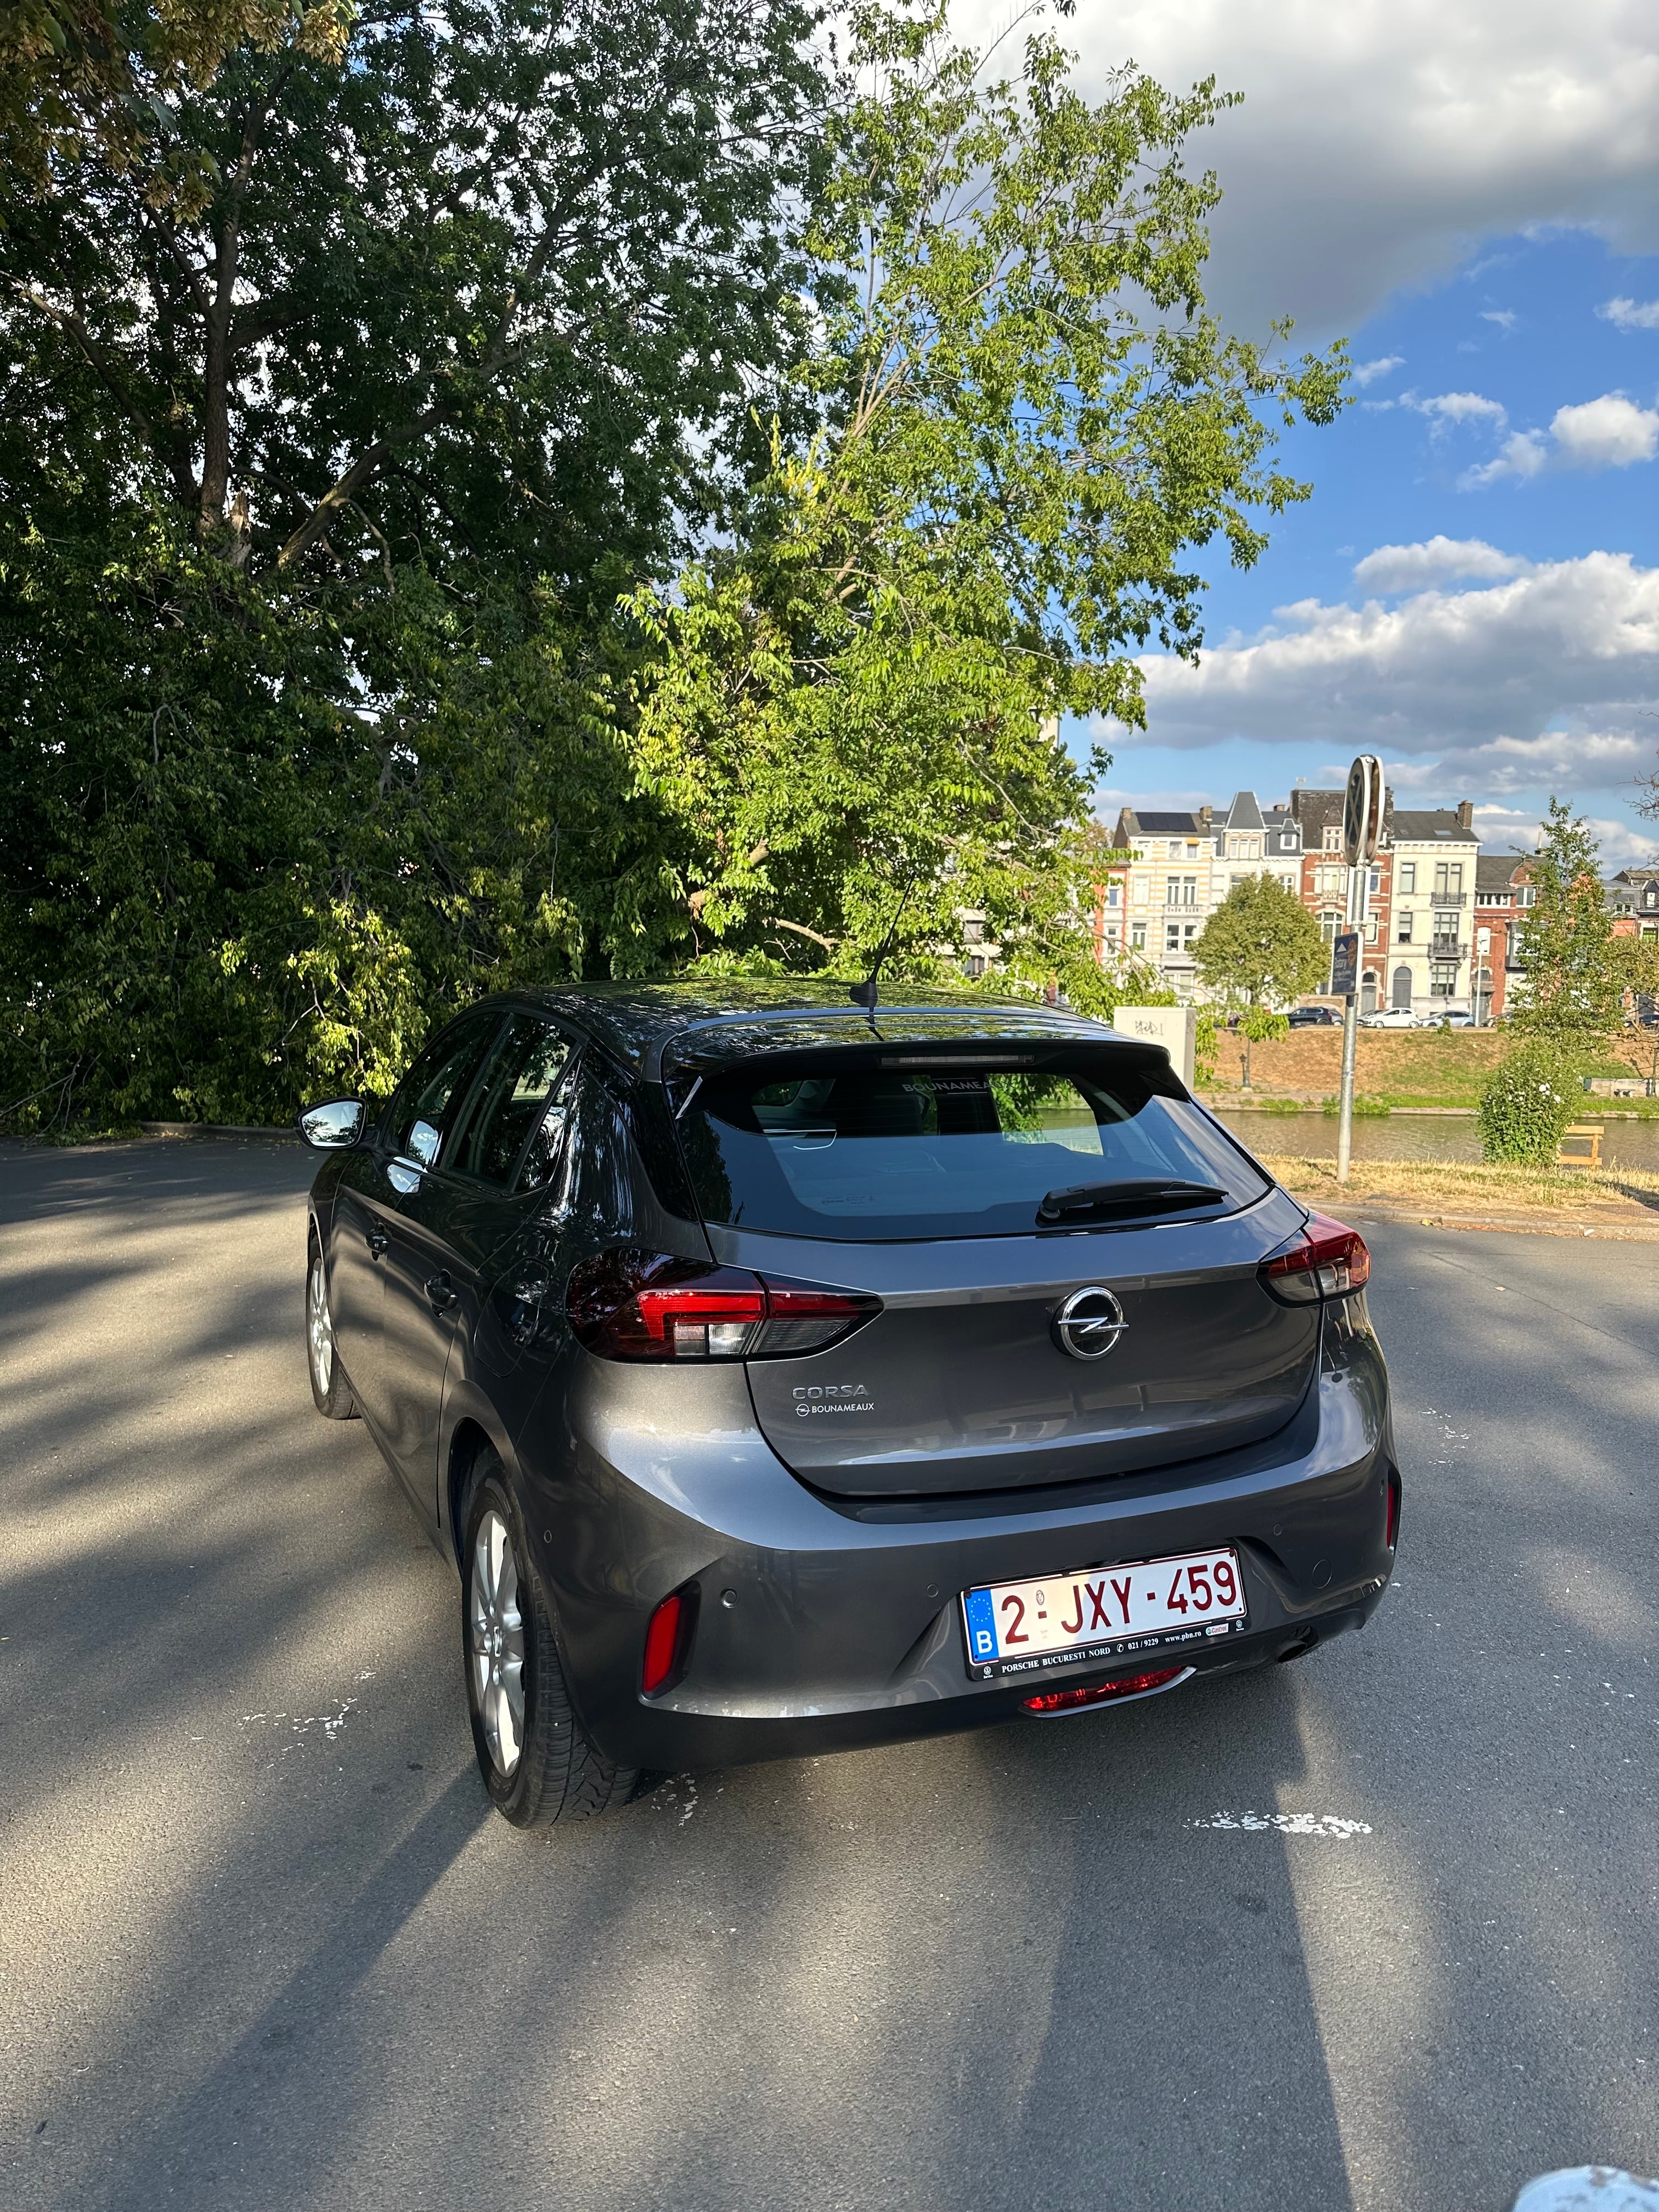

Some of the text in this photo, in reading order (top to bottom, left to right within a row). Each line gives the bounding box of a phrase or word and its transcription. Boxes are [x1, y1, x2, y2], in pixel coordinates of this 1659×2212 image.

[792, 1384, 870, 1400] CORSA
[811, 1402, 874, 1413] BOUNAMEAUX
[1211, 1625, 1227, 1634] Castrol
[977, 1630, 992, 1654] B
[1002, 1660, 1039, 1673] PORSCHE
[1042, 1651, 1086, 1666] BUCURESTI
[1088, 1647, 1111, 1658] NORD
[1165, 1631, 1202, 1643] www.pbn.ro
